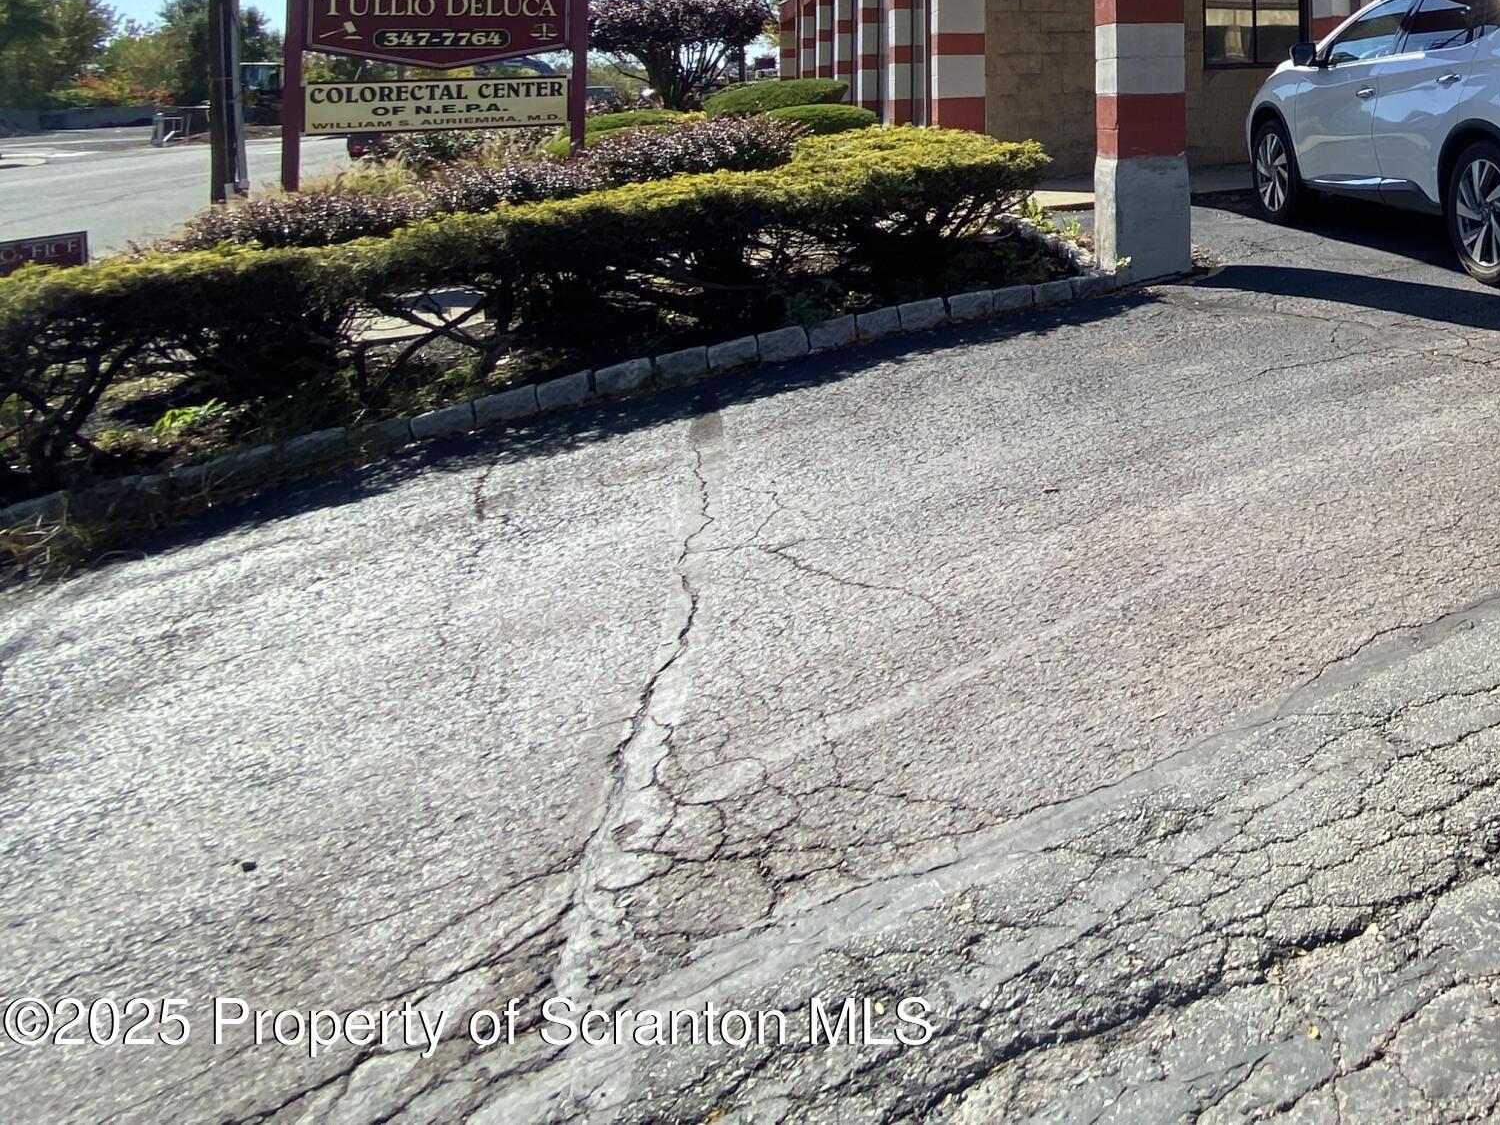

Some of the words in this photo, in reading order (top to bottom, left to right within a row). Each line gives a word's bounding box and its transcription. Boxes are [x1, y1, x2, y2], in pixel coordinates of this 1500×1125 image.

[383, 32, 502, 46] 347-7764
[309, 83, 468, 104] COLORECTAL
[477, 80, 564, 99] CENTER
[371, 106, 408, 116] OF
[415, 102, 509, 115] N.E.P.A.
[311, 120, 393, 130] WILLIAM
[527, 113, 563, 121] M.D.
